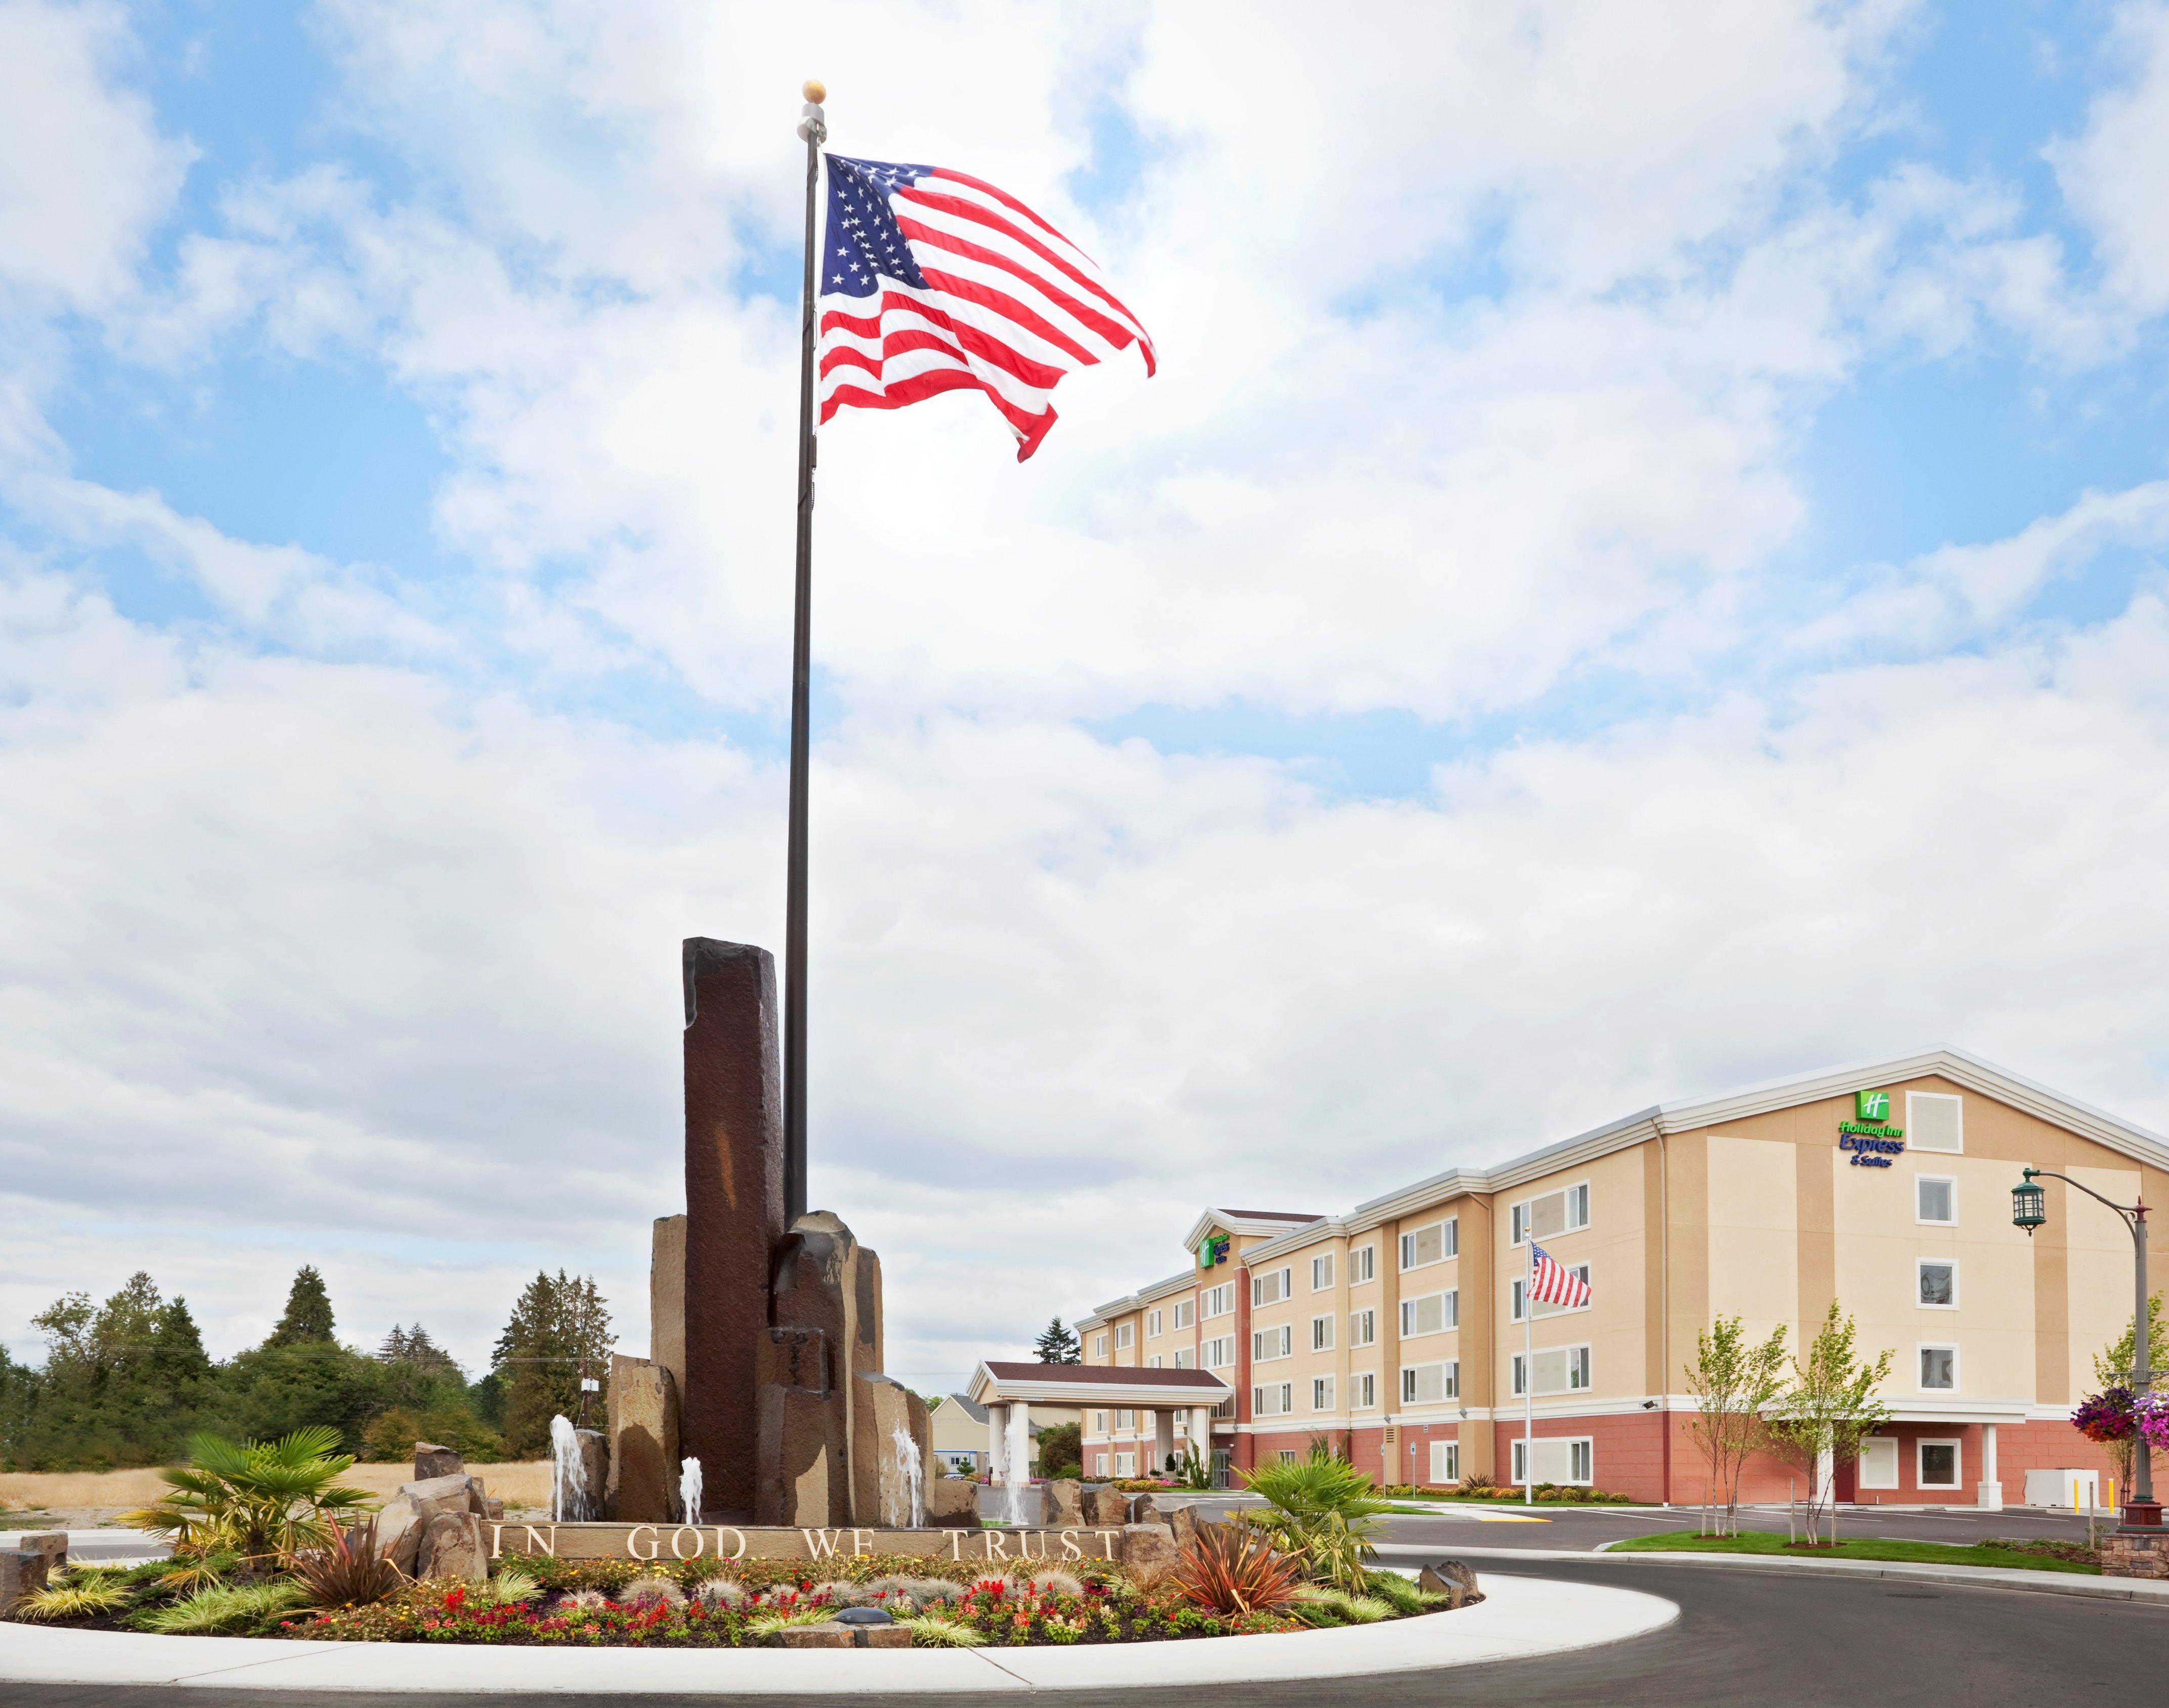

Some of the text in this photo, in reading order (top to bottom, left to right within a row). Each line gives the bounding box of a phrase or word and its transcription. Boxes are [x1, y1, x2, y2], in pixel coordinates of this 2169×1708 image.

[1840, 1121, 1904, 1138] Holiday Inn
[1839, 1133, 1905, 1154] Express
[1850, 1154, 1892, 1167] & Suites
[490, 1524, 1120, 1562] IN GOD WE TRUST
